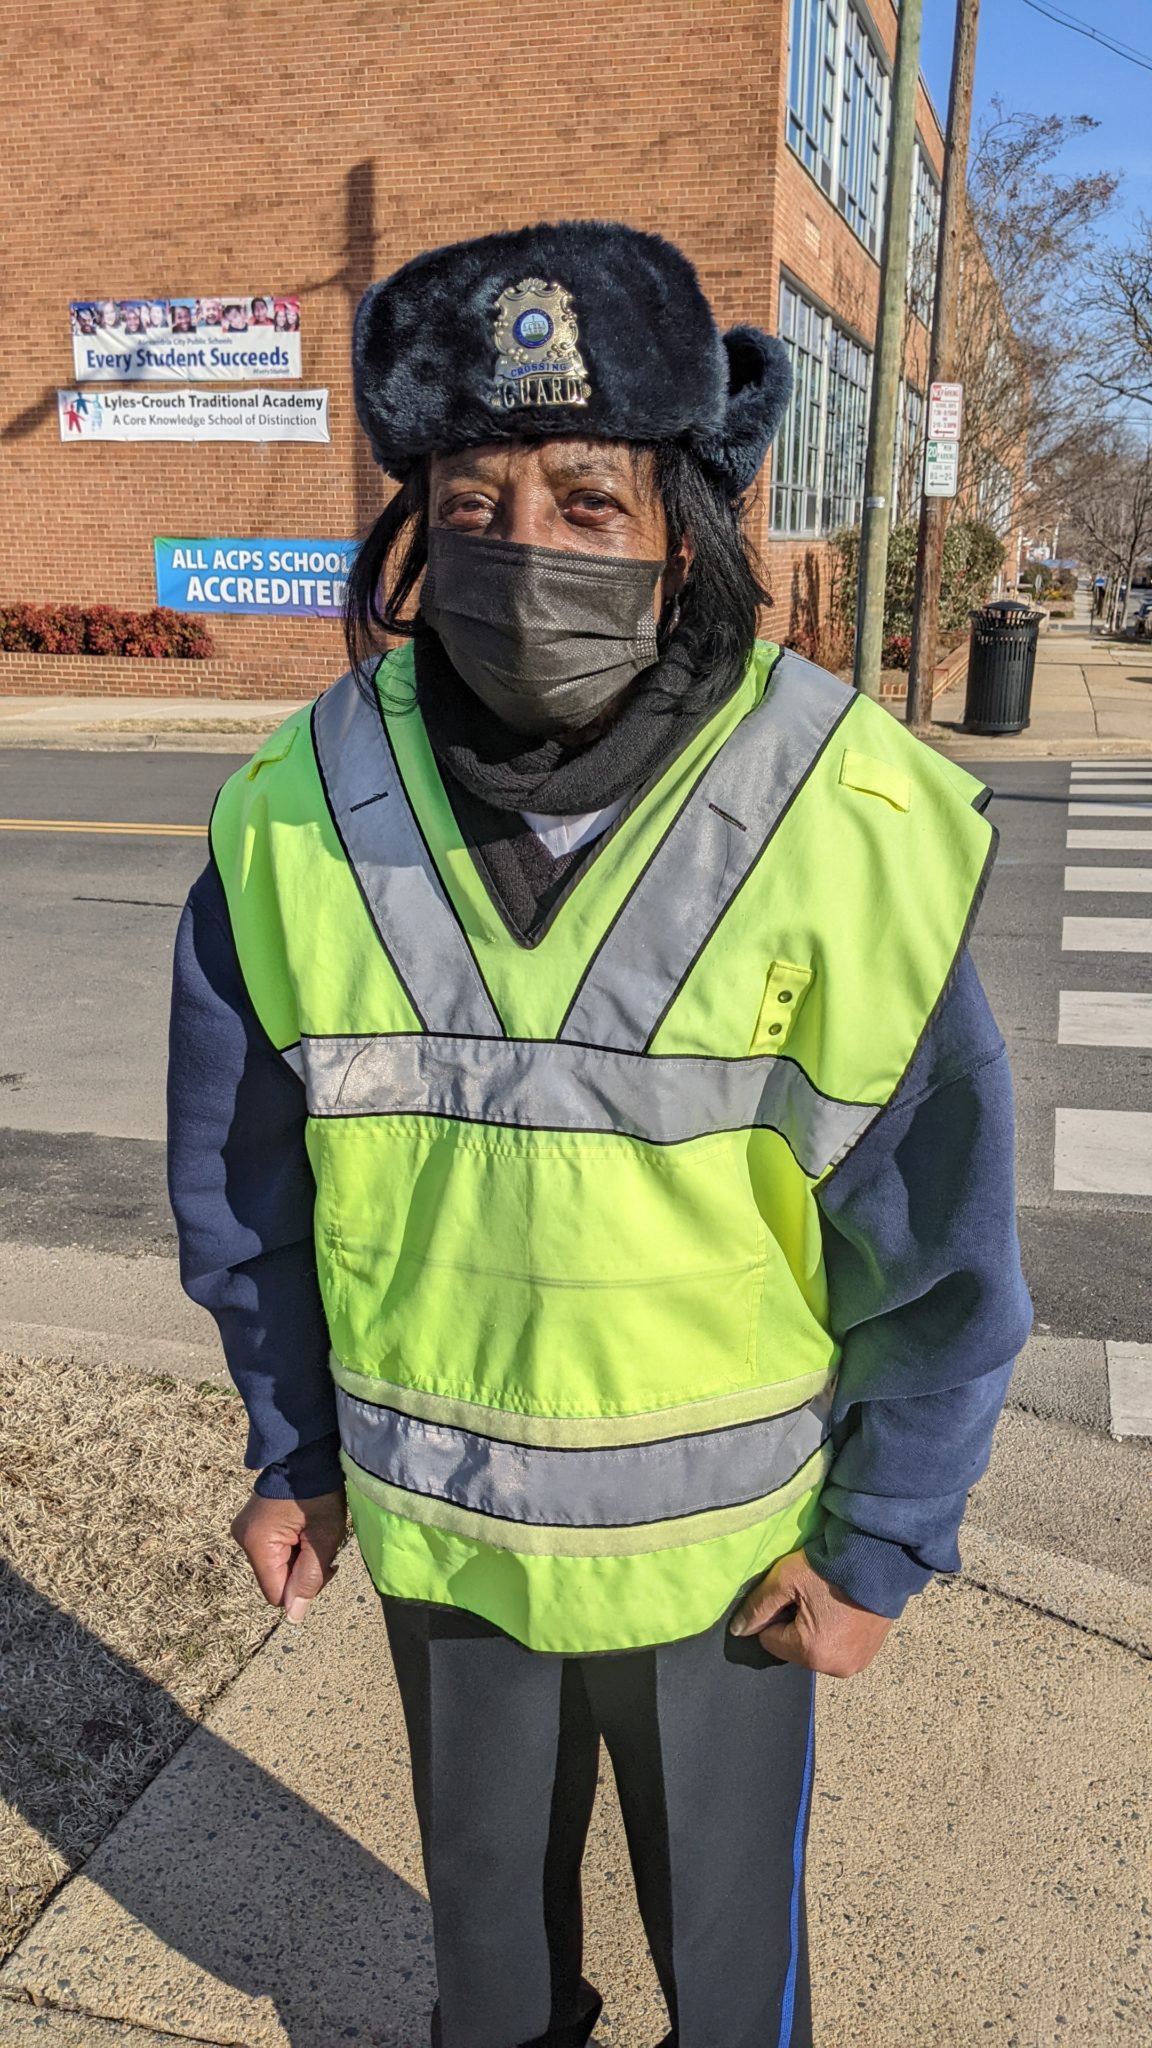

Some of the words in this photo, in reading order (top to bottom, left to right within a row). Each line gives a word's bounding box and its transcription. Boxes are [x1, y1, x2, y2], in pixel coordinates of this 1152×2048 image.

[173, 338, 186, 347] City
[207, 337, 233, 345] Schools
[87, 349, 132, 373] Every
[136, 346, 205, 368] Student
[210, 345, 290, 368] Succeeds
[510, 362, 567, 378] CROSSING
[503, 377, 583, 409] GUARD
[104, 394, 185, 410] Lyles-Crouch
[188, 394, 259, 409] Traditional
[262, 394, 324, 411] Academy
[113, 415, 121, 425] A
[123, 415, 147, 426] Core
[149, 414, 206, 428] Knowledge
[208, 414, 243, 426] School
[245, 414, 257, 425] of
[258, 414, 317, 426] Distinction
[928, 446, 937, 458] 20
[172, 549, 208, 569] ALL
[213, 549, 264, 571] ACPS
[269, 551, 351, 575] SCHOOL
